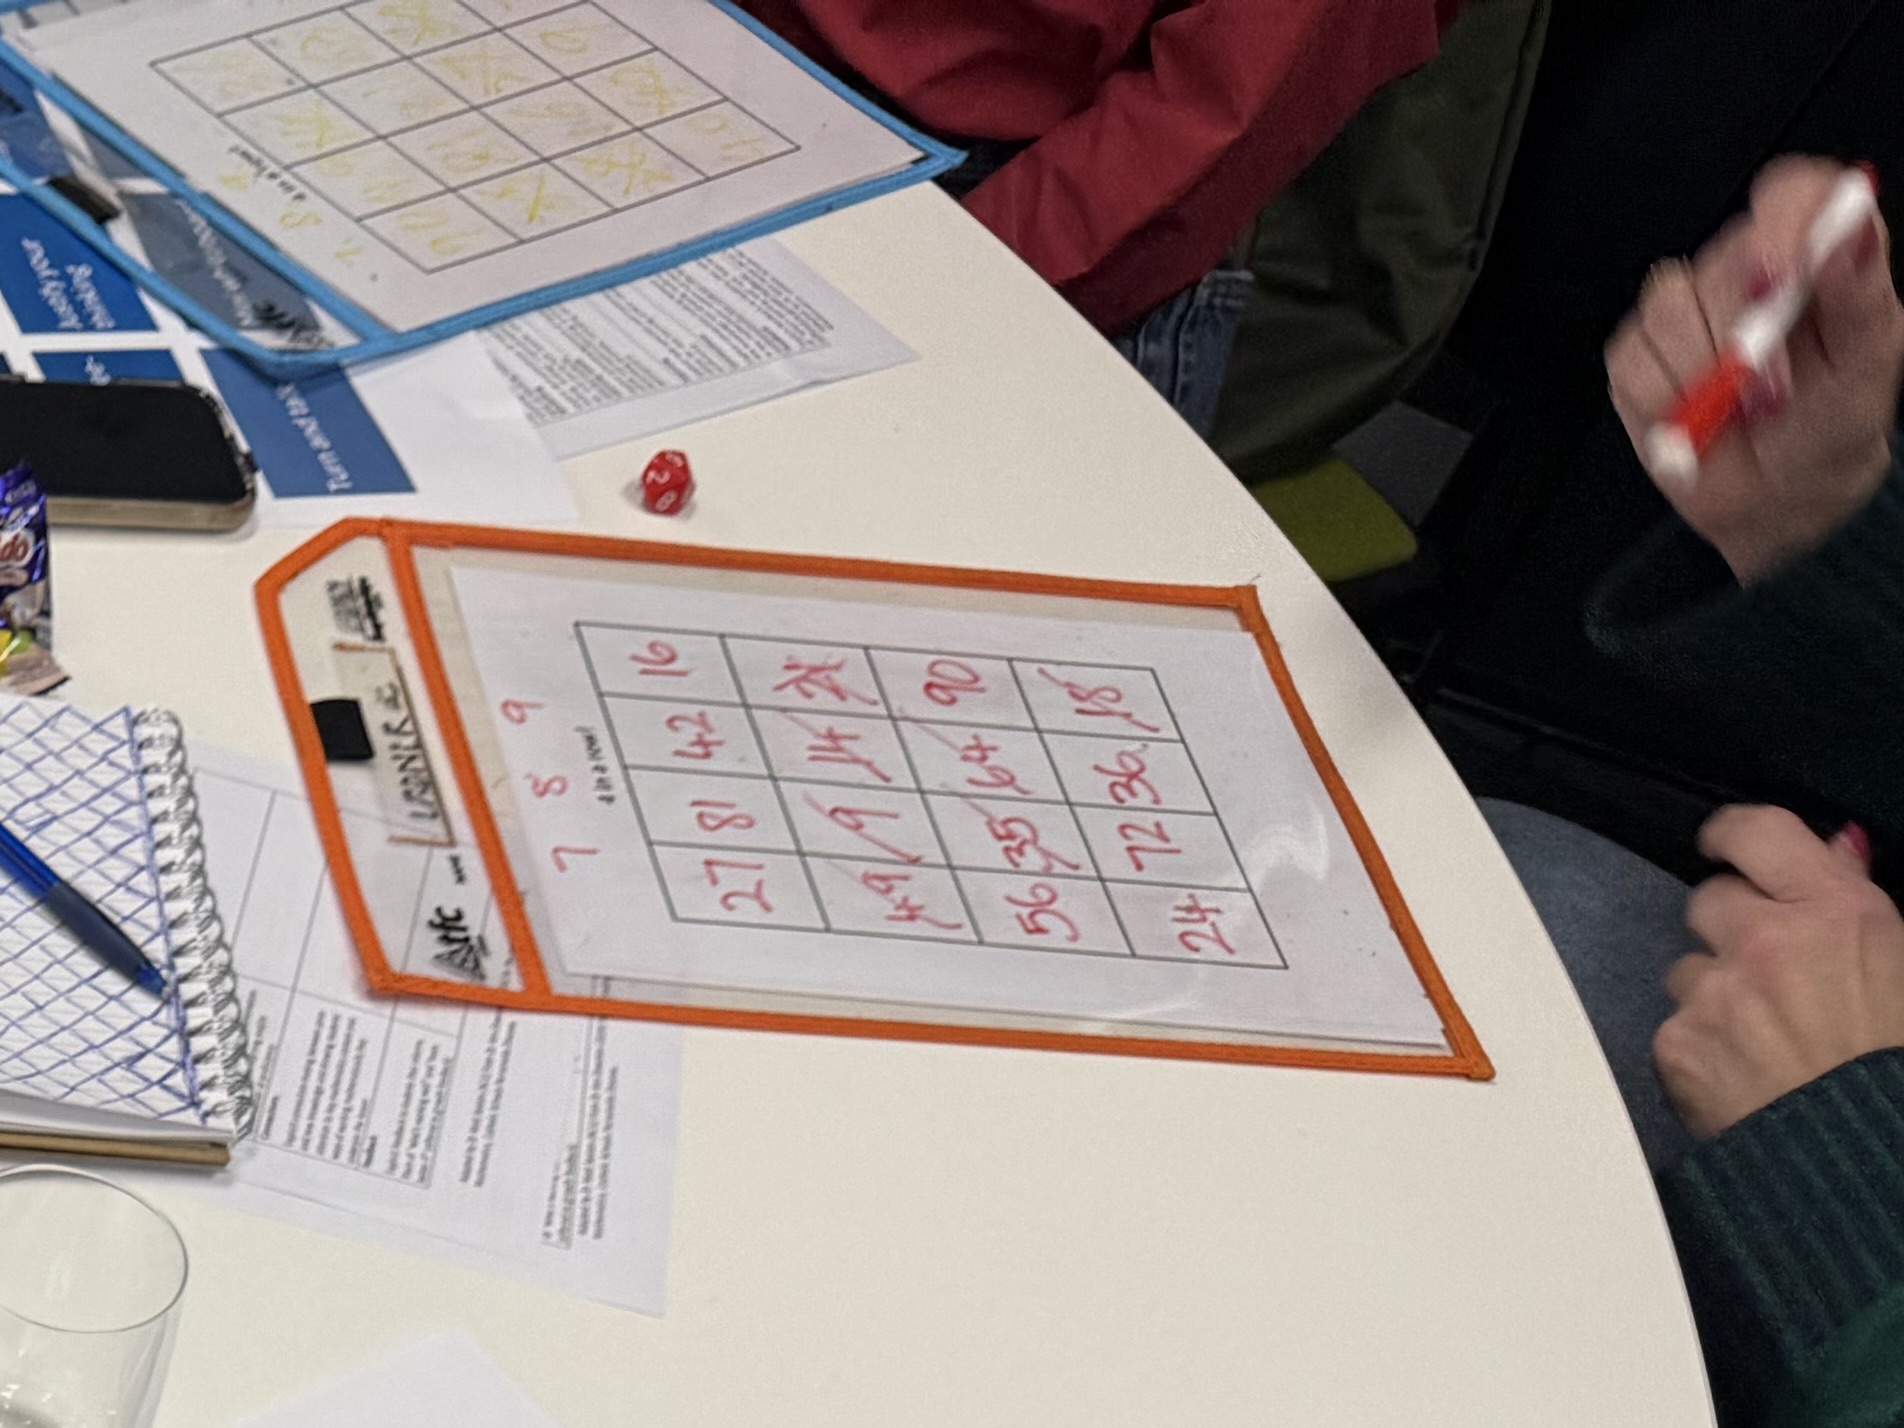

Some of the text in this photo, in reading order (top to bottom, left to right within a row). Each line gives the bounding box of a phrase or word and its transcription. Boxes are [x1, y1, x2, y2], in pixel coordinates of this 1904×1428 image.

[628, 639, 773, 914] 27 81 42 16
